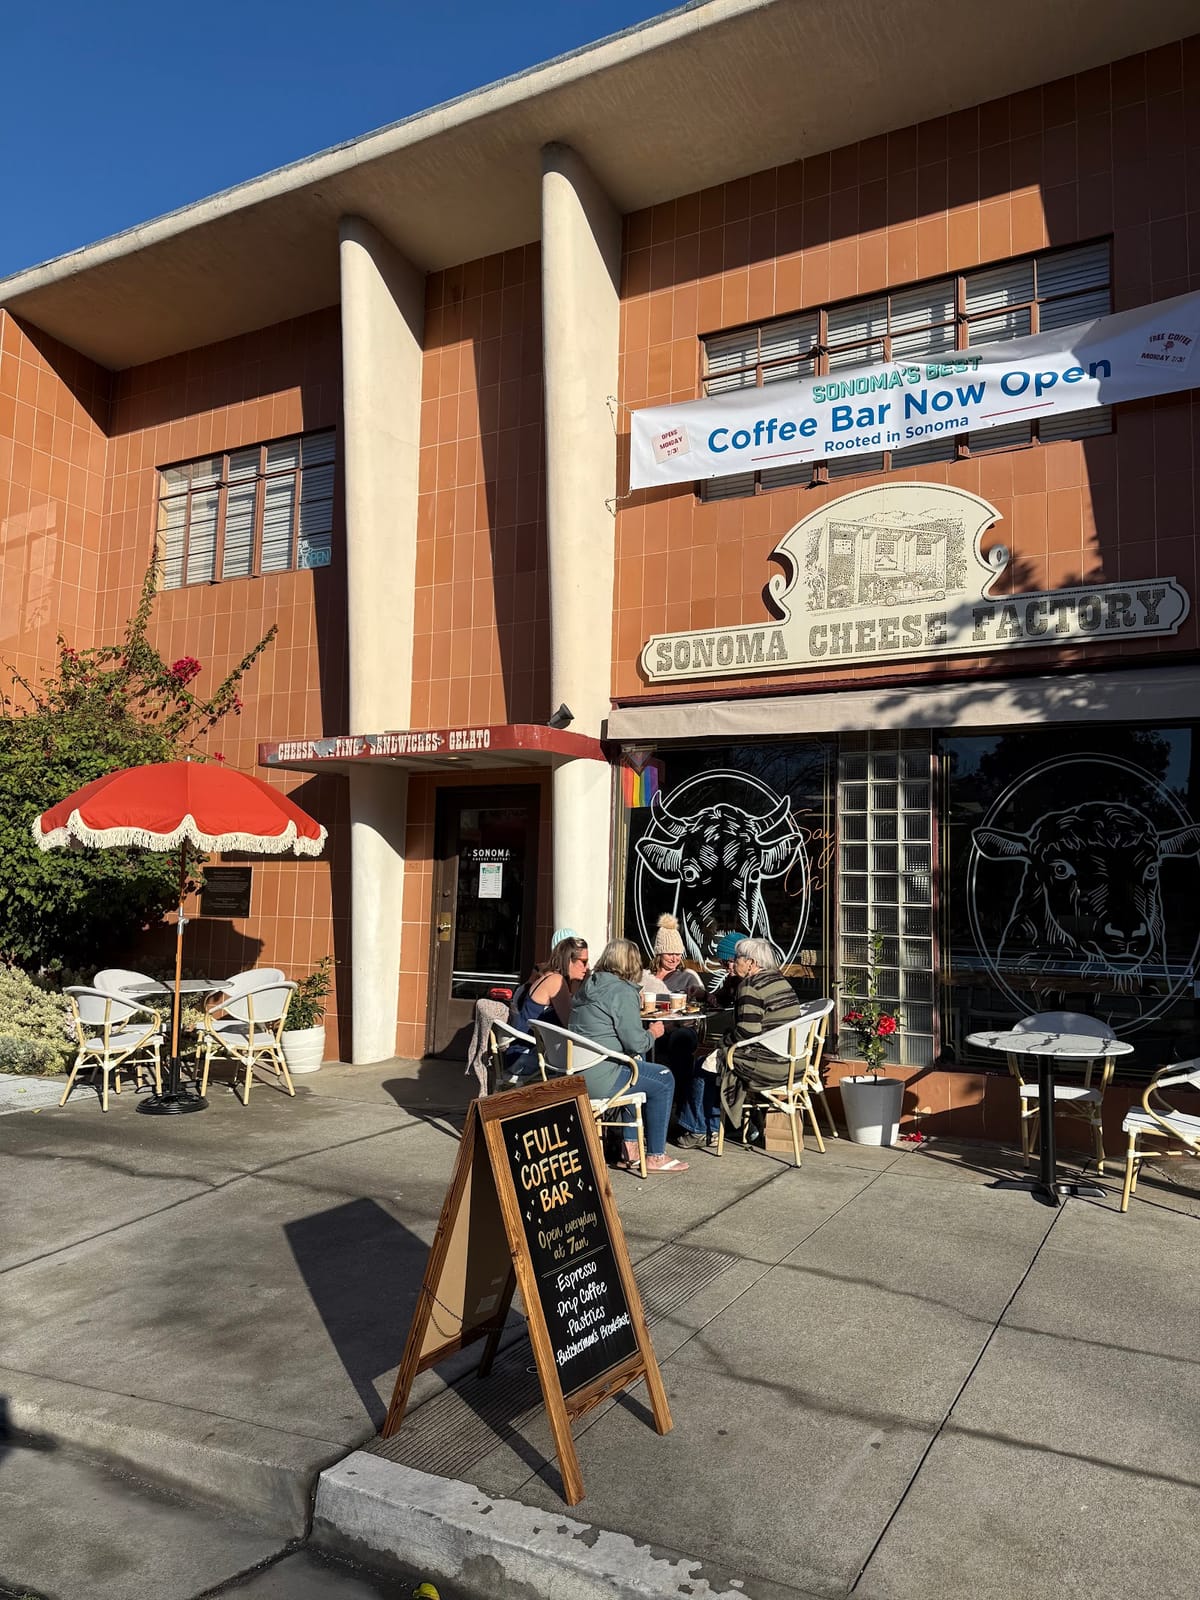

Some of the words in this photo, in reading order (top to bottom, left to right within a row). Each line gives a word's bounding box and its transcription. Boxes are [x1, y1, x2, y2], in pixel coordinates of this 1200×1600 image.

[812, 366, 921, 403] SONOMA'S
[925, 356, 983, 380] BEST
[708, 418, 818, 453] Coffee
[831, 403, 891, 433] Bar
[904, 381, 987, 420] Now
[1001, 359, 1112, 397] Open
[660, 436, 683, 450] MONDAY
[824, 432, 881, 452] Rooted
[887, 430, 900, 443] in
[905, 416, 969, 439] Sonoma
[656, 630, 788, 672] SONOMA
[808, 611, 947, 657] CHEESE
[972, 588, 1166, 641] FACTORY
[278, 741, 315, 760] CHEESE
[448, 729, 491, 750] GELATO
[472, 849, 511, 857] SONOMA
[522, 1123, 568, 1160] FULL
[520, 1149, 582, 1191] COFFEE
[539, 1181, 574, 1213] BAR
[538, 1227, 563, 1250] Open
[565, 1210, 598, 1233] everyday
[554, 1243, 566, 1259] at
[566, 1236, 589, 1255] 7am
[579, 1281, 608, 1304] Coffee
